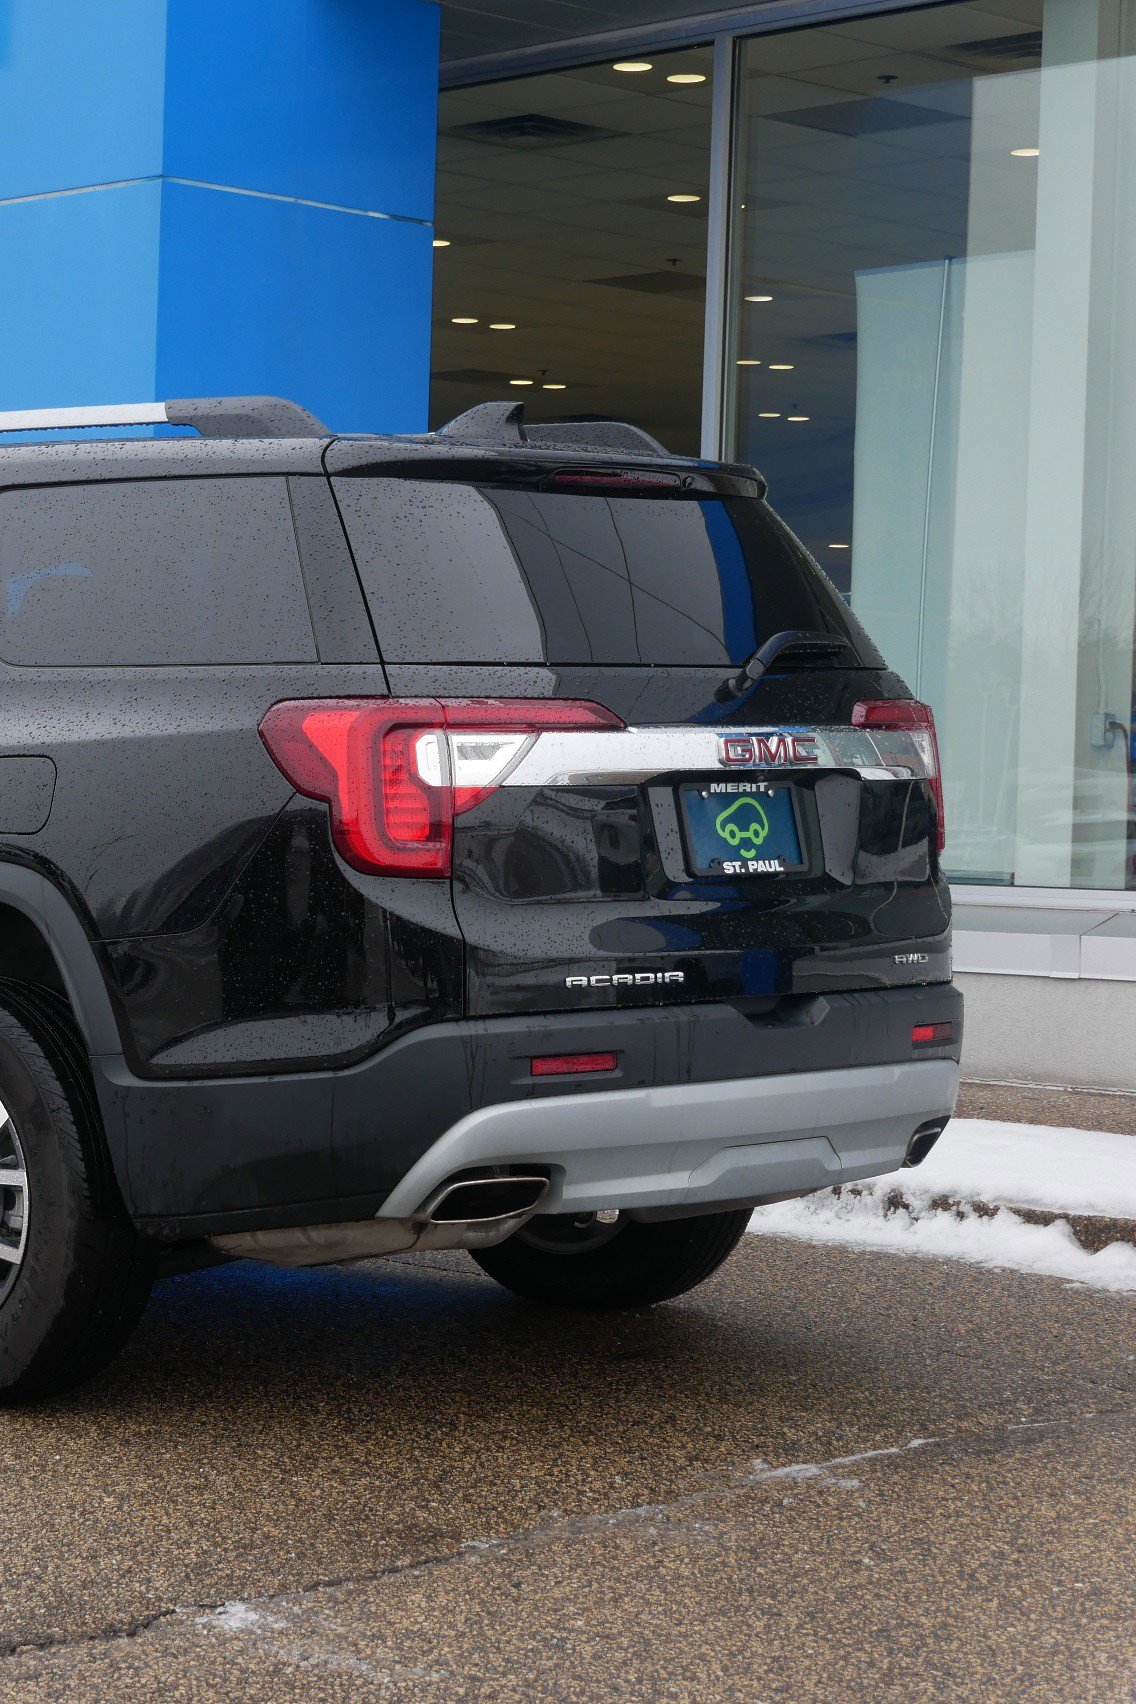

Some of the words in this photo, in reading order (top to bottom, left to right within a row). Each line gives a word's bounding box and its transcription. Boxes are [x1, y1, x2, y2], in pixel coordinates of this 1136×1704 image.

[720, 735, 820, 765] GMC
[710, 782, 768, 794] MERIT
[722, 861, 745, 875] ST.
[747, 860, 785, 873] PAUL
[894, 953, 929, 964] AWD
[565, 971, 685, 989] ACADIA
